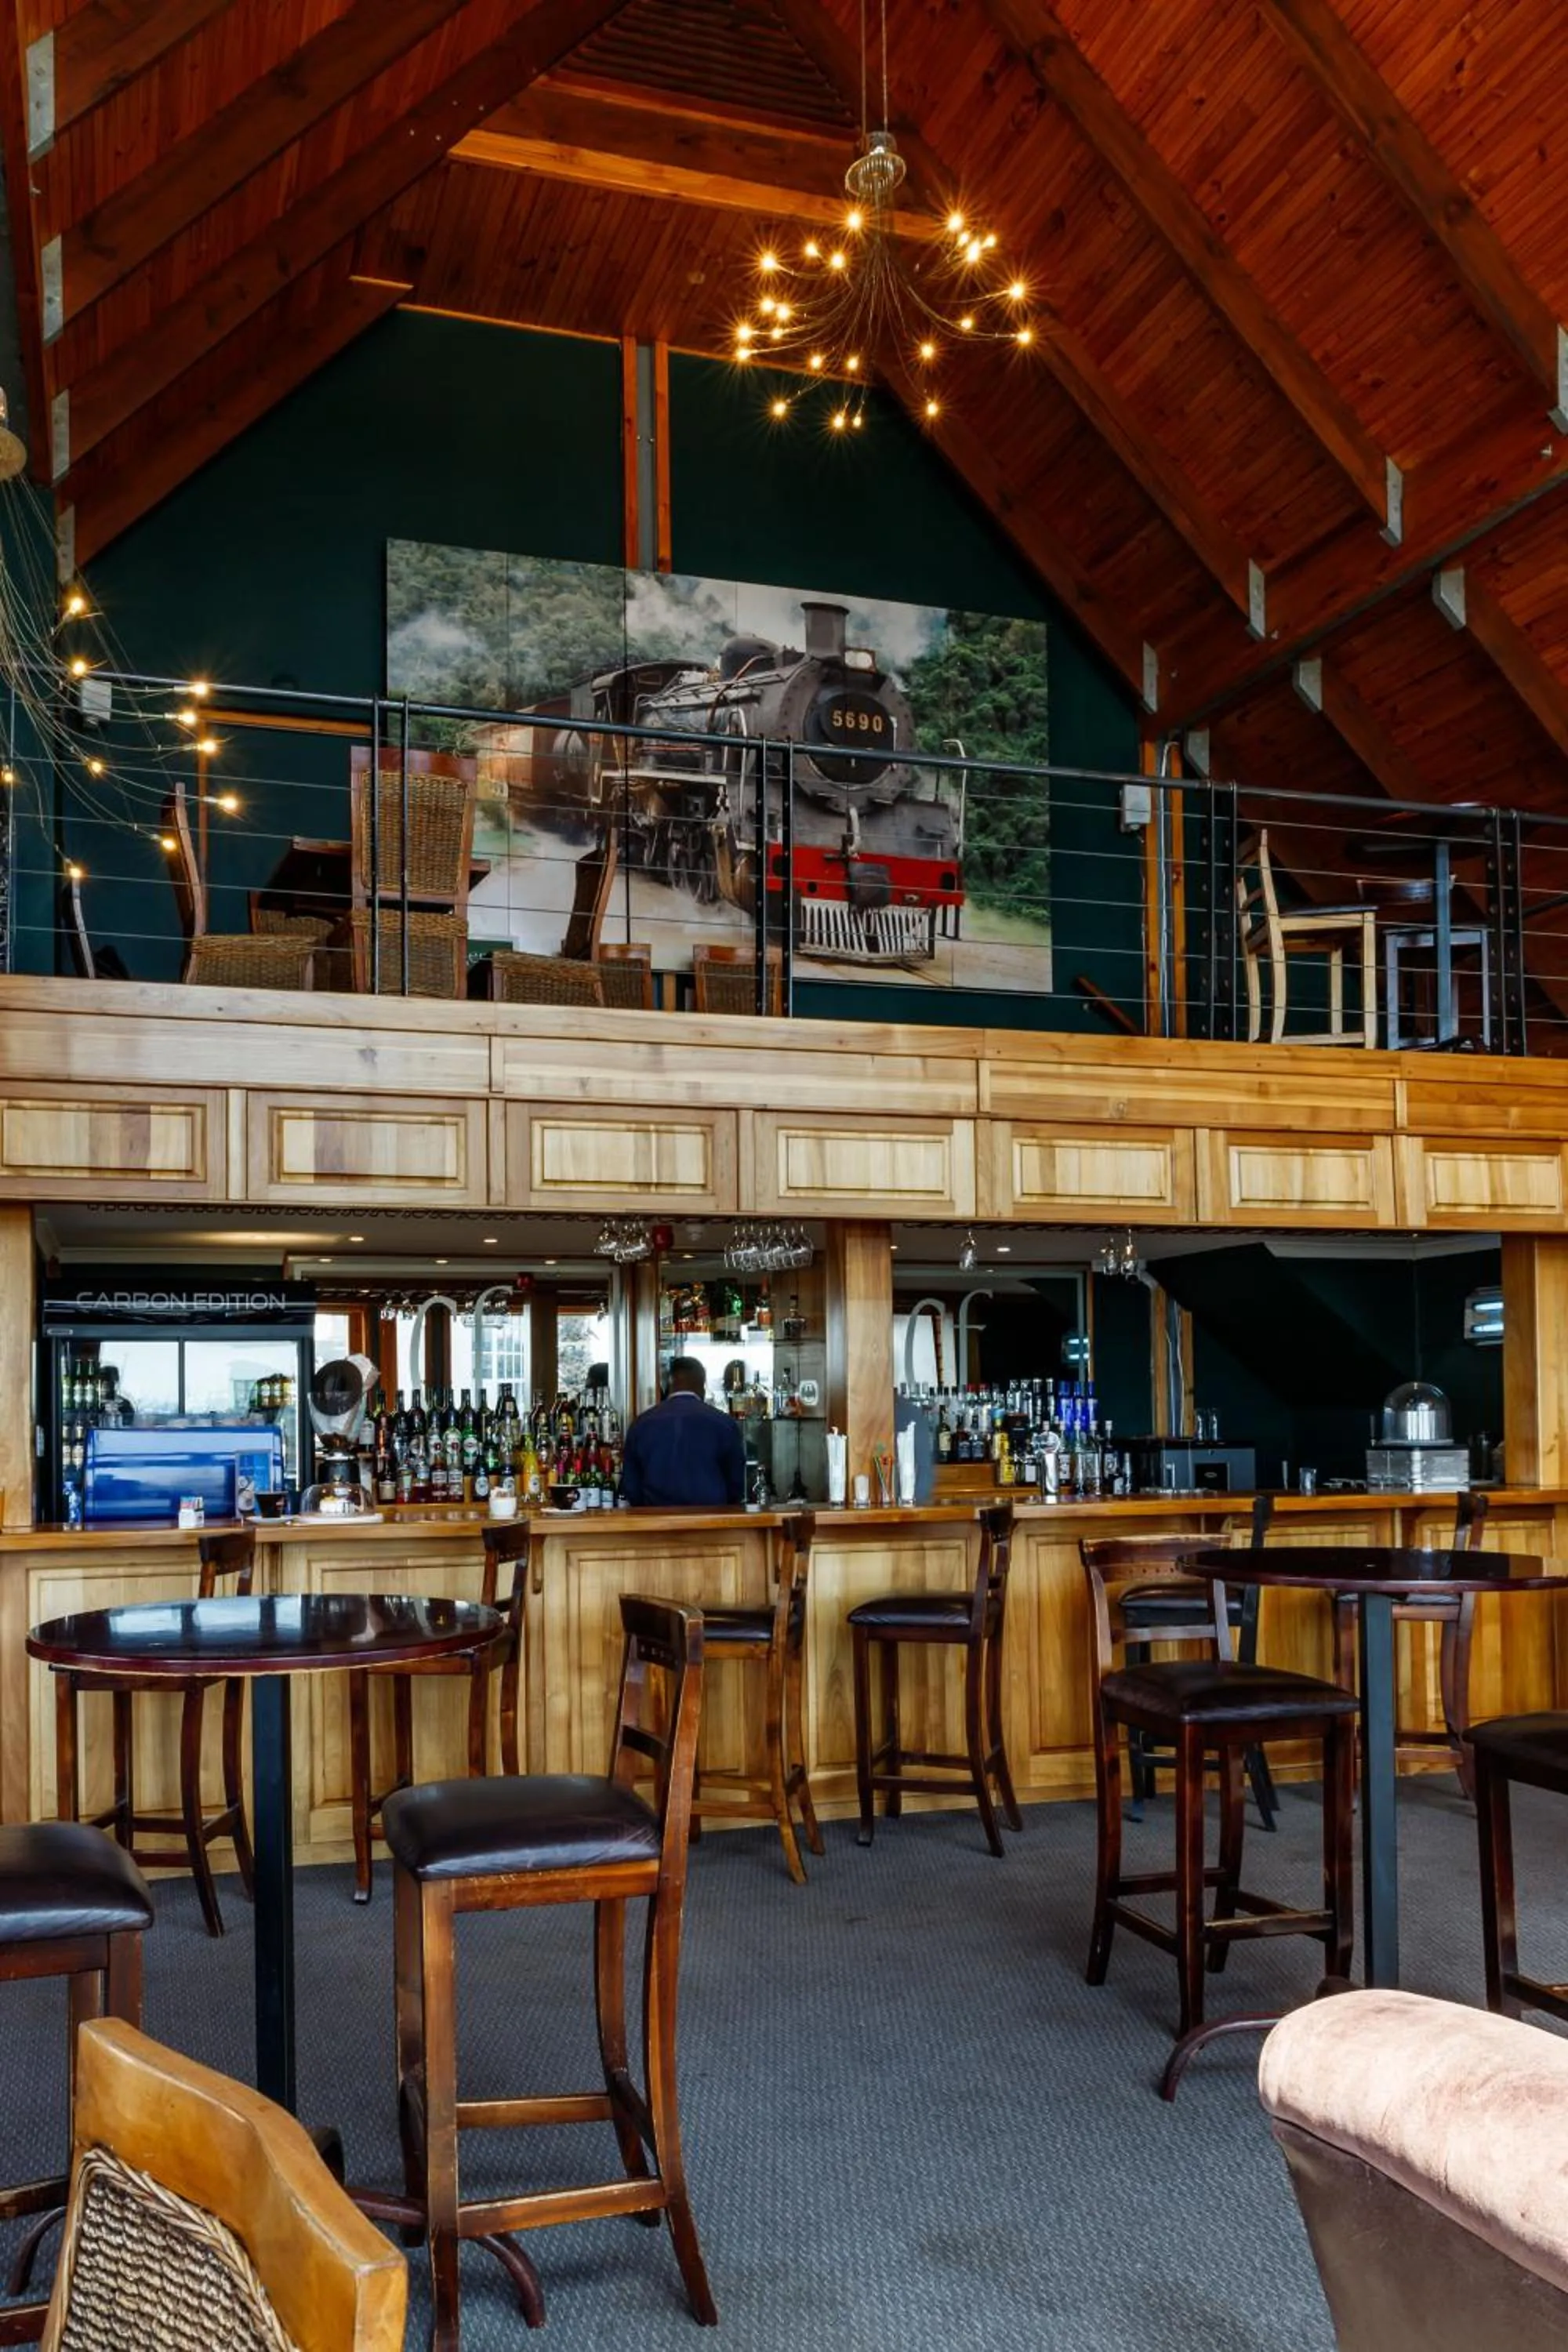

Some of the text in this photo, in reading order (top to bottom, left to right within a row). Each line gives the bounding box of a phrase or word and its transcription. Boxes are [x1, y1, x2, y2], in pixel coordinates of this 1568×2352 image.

[832, 710, 883, 733] 5690
[76, 1291, 286, 1310] CARBON EDITION
